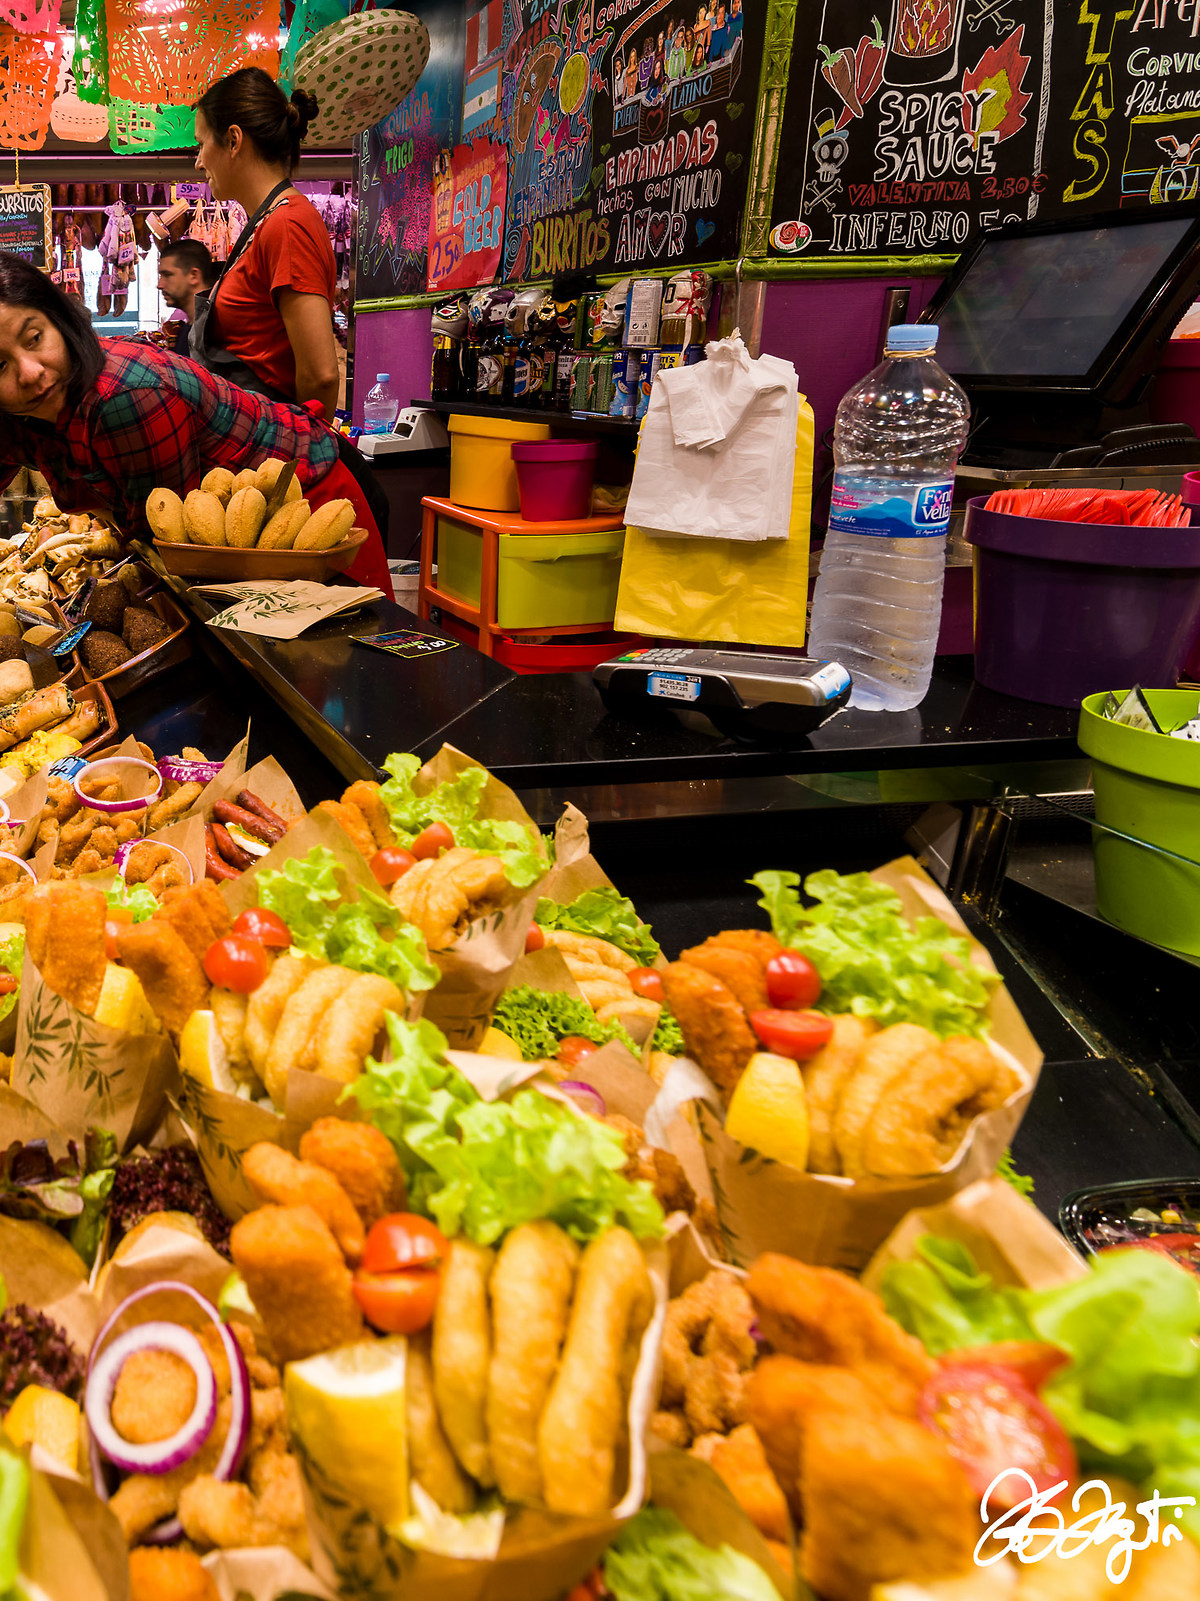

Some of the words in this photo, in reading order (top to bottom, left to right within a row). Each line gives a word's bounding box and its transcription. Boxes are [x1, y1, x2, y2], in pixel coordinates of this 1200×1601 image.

[388, 90, 430, 139] QUINOA
[672, 73, 713, 111] LATINO
[878, 87, 998, 137] SPICY
[385, 137, 414, 175] TRIGO
[605, 119, 719, 193] EMPANADAS
[873, 130, 1000, 183] SAUCE
[453, 173, 492, 228] COLD
[512, 170, 576, 229] EMPANADA
[597, 185, 634, 216] hechas
[671, 168, 722, 215] MUCHO
[848, 181, 971, 207] VALENTINA
[980, 173, 1049, 200] 2,50€
[464, 205, 503, 255] BEER
[530, 208, 611, 278] BURRITOS
[828, 210, 970, 252] INFERNO
[921, 502, 949, 521] Vella
